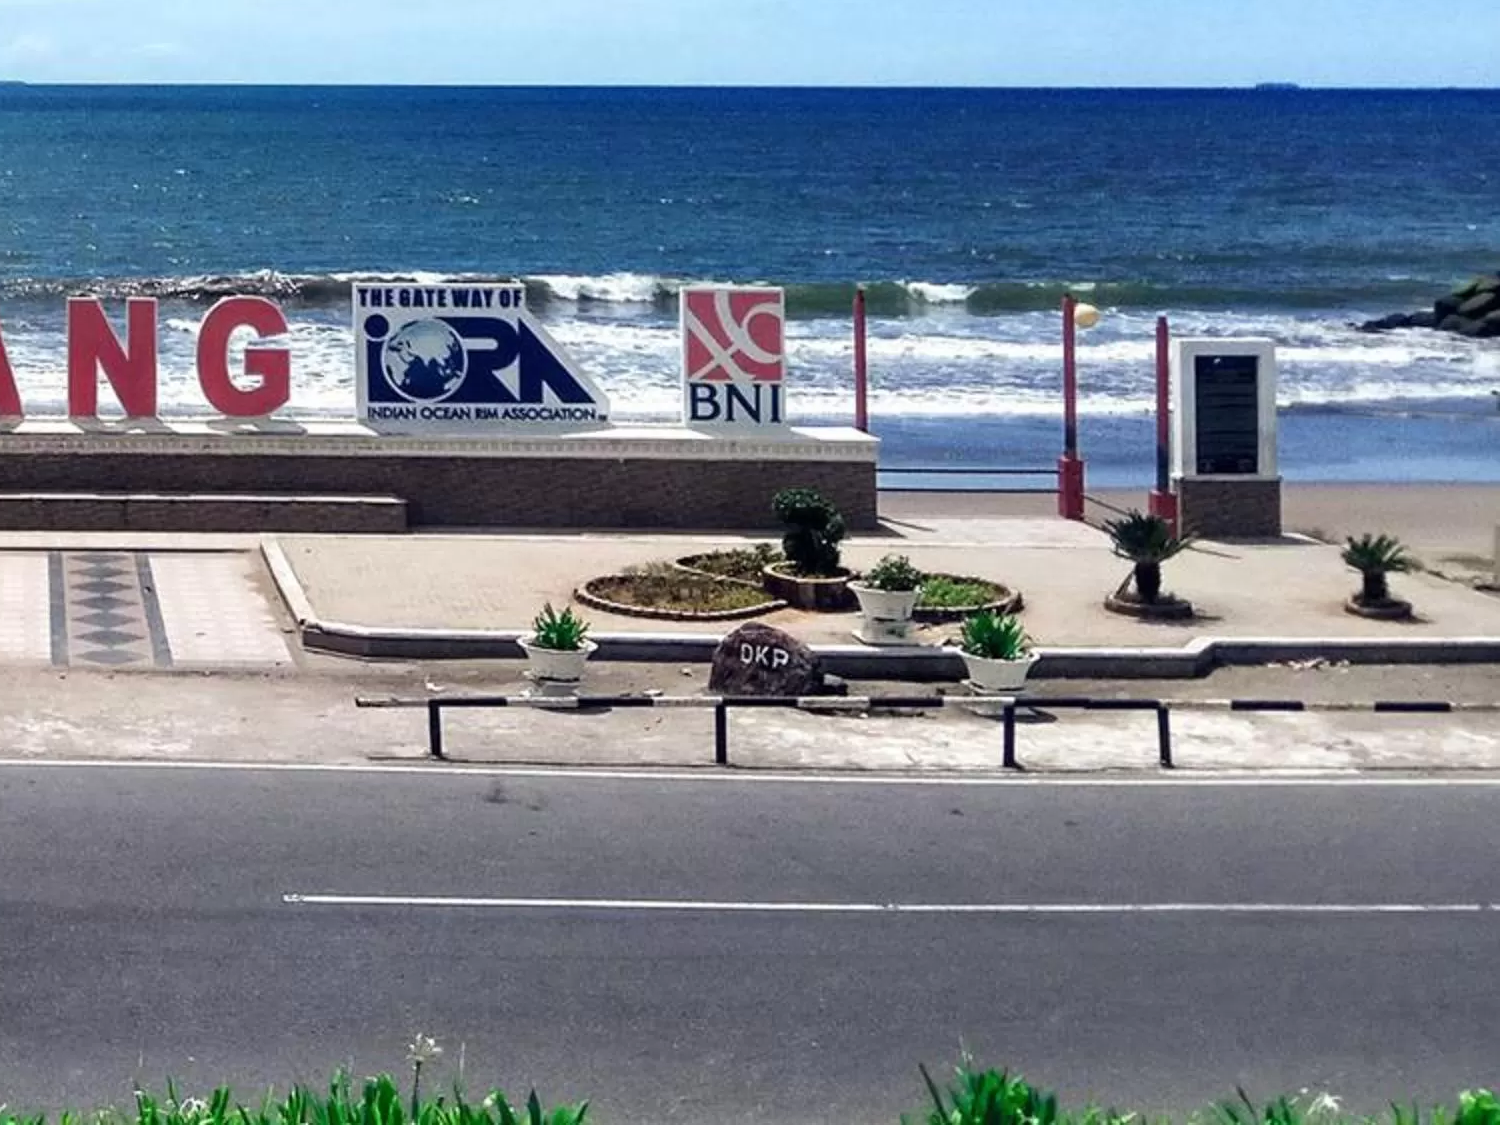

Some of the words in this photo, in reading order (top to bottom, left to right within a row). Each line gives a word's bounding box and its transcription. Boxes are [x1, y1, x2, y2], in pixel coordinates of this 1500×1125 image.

[357, 288, 395, 308] THE
[400, 288, 447, 308] GATE
[452, 288, 494, 308] WAY
[499, 288, 523, 308] OF
[367, 406, 417, 420] INDIAN
[420, 406, 471, 420] OCEAN
[475, 406, 500, 420] RIM
[502, 406, 596, 421] ASSOCIATION
[689, 382, 782, 423] BNI
[740, 642, 789, 669] DKP
